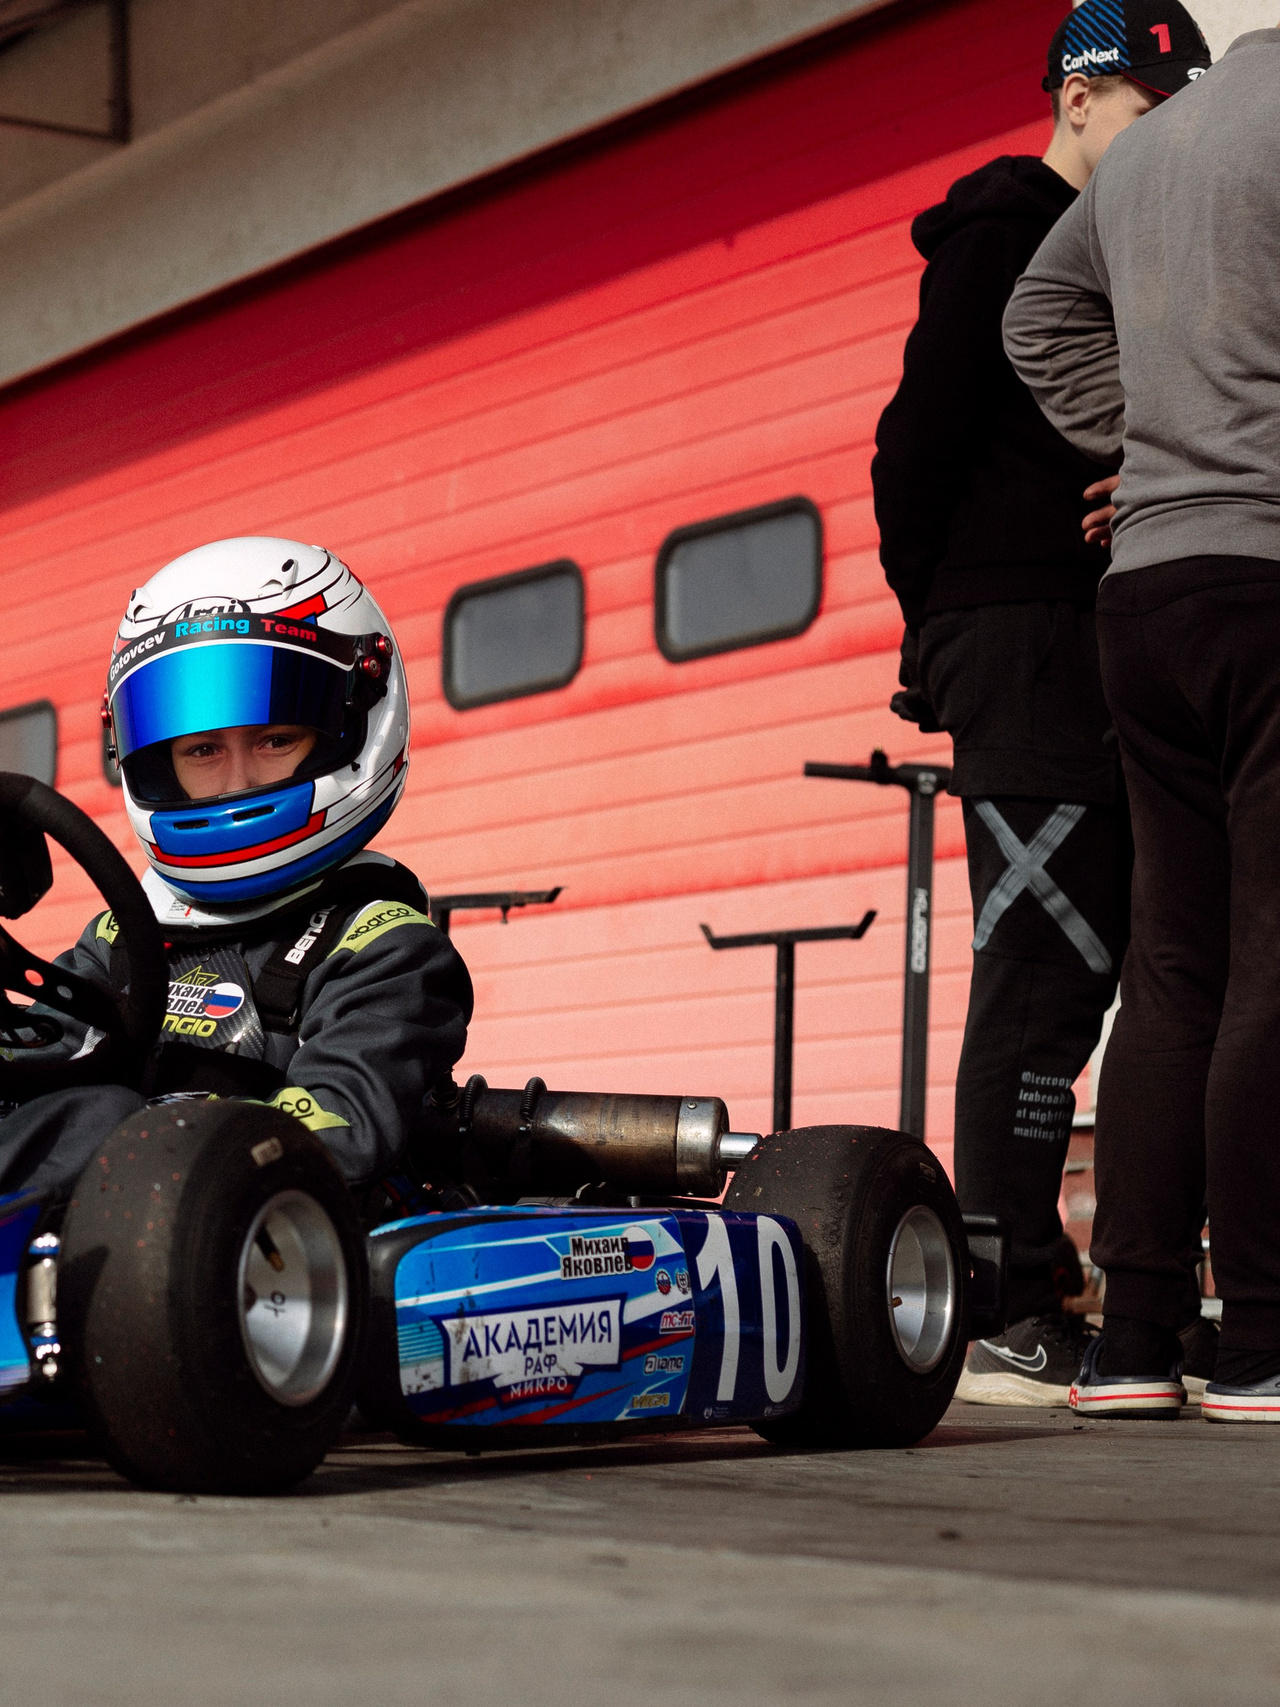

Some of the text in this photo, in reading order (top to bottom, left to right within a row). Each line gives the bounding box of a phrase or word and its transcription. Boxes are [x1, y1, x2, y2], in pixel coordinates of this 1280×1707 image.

[1149, 23, 1171, 53] 1
[1062, 46, 1119, 72] CarNext
[109, 616, 318, 681] Gotovcev Racing Team
[168, 983, 217, 1001] ихаил
[571, 1237, 630, 1257] Михаил
[562, 1255, 634, 1278] Яковлев
[695, 1213, 801, 1403] 10
[462, 1310, 612, 1363] АКАДЕМИЯ
[524, 1353, 558, 1377] РАФ
[510, 1375, 569, 1400] МИКРО
